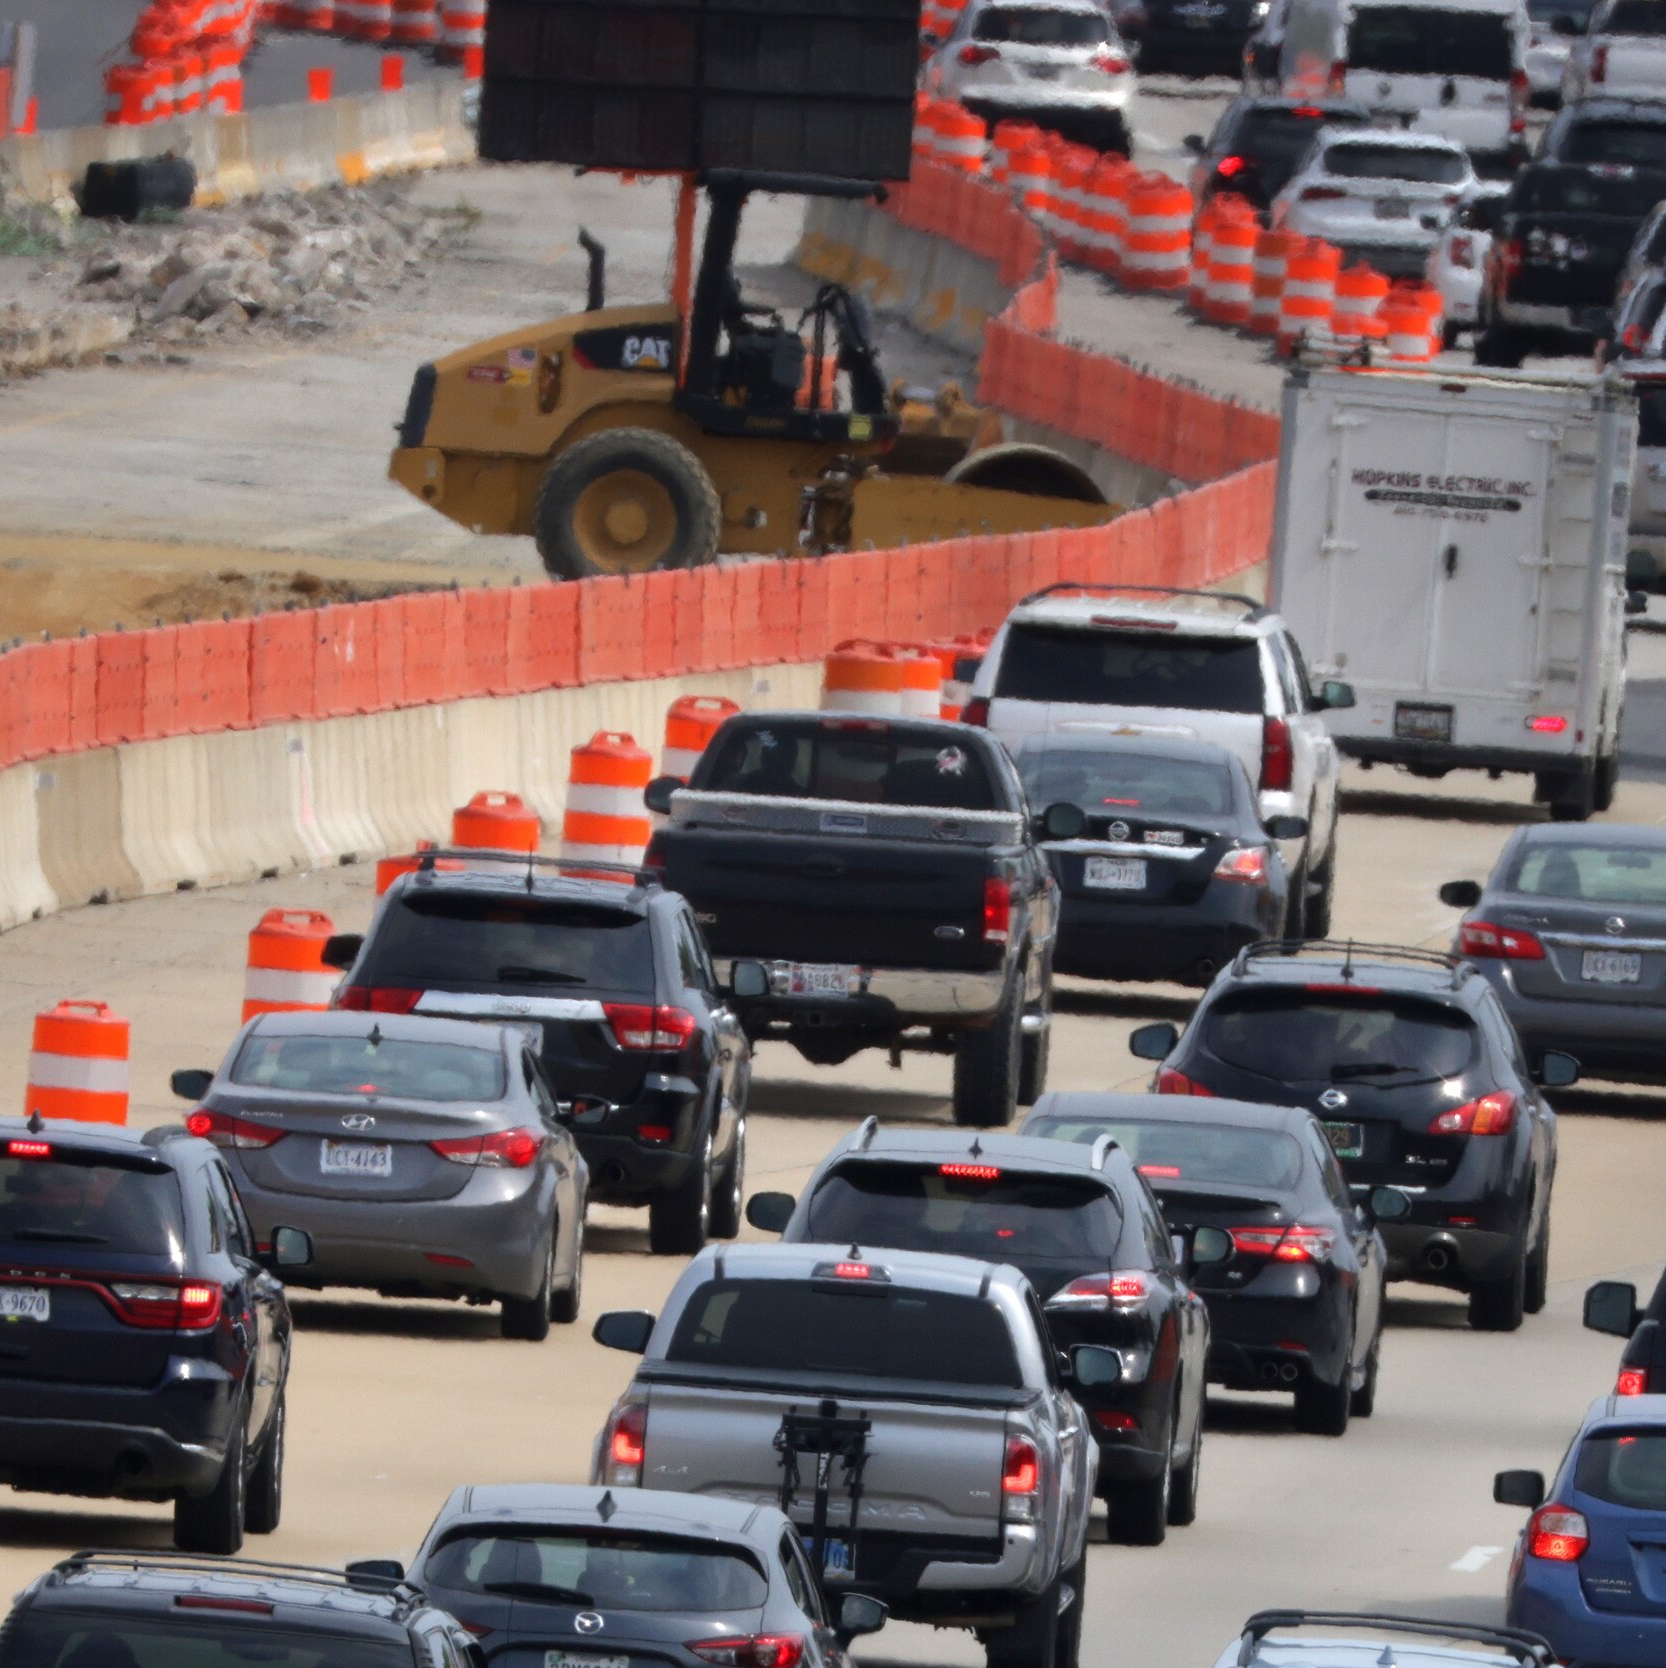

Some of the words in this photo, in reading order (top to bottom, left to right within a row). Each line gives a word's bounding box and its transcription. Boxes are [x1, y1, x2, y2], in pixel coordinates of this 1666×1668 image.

[623, 335, 671, 369] CAT
[1351, 467, 1422, 488] HOPKINS
[1426, 474, 1501, 495] ELECTRIC
